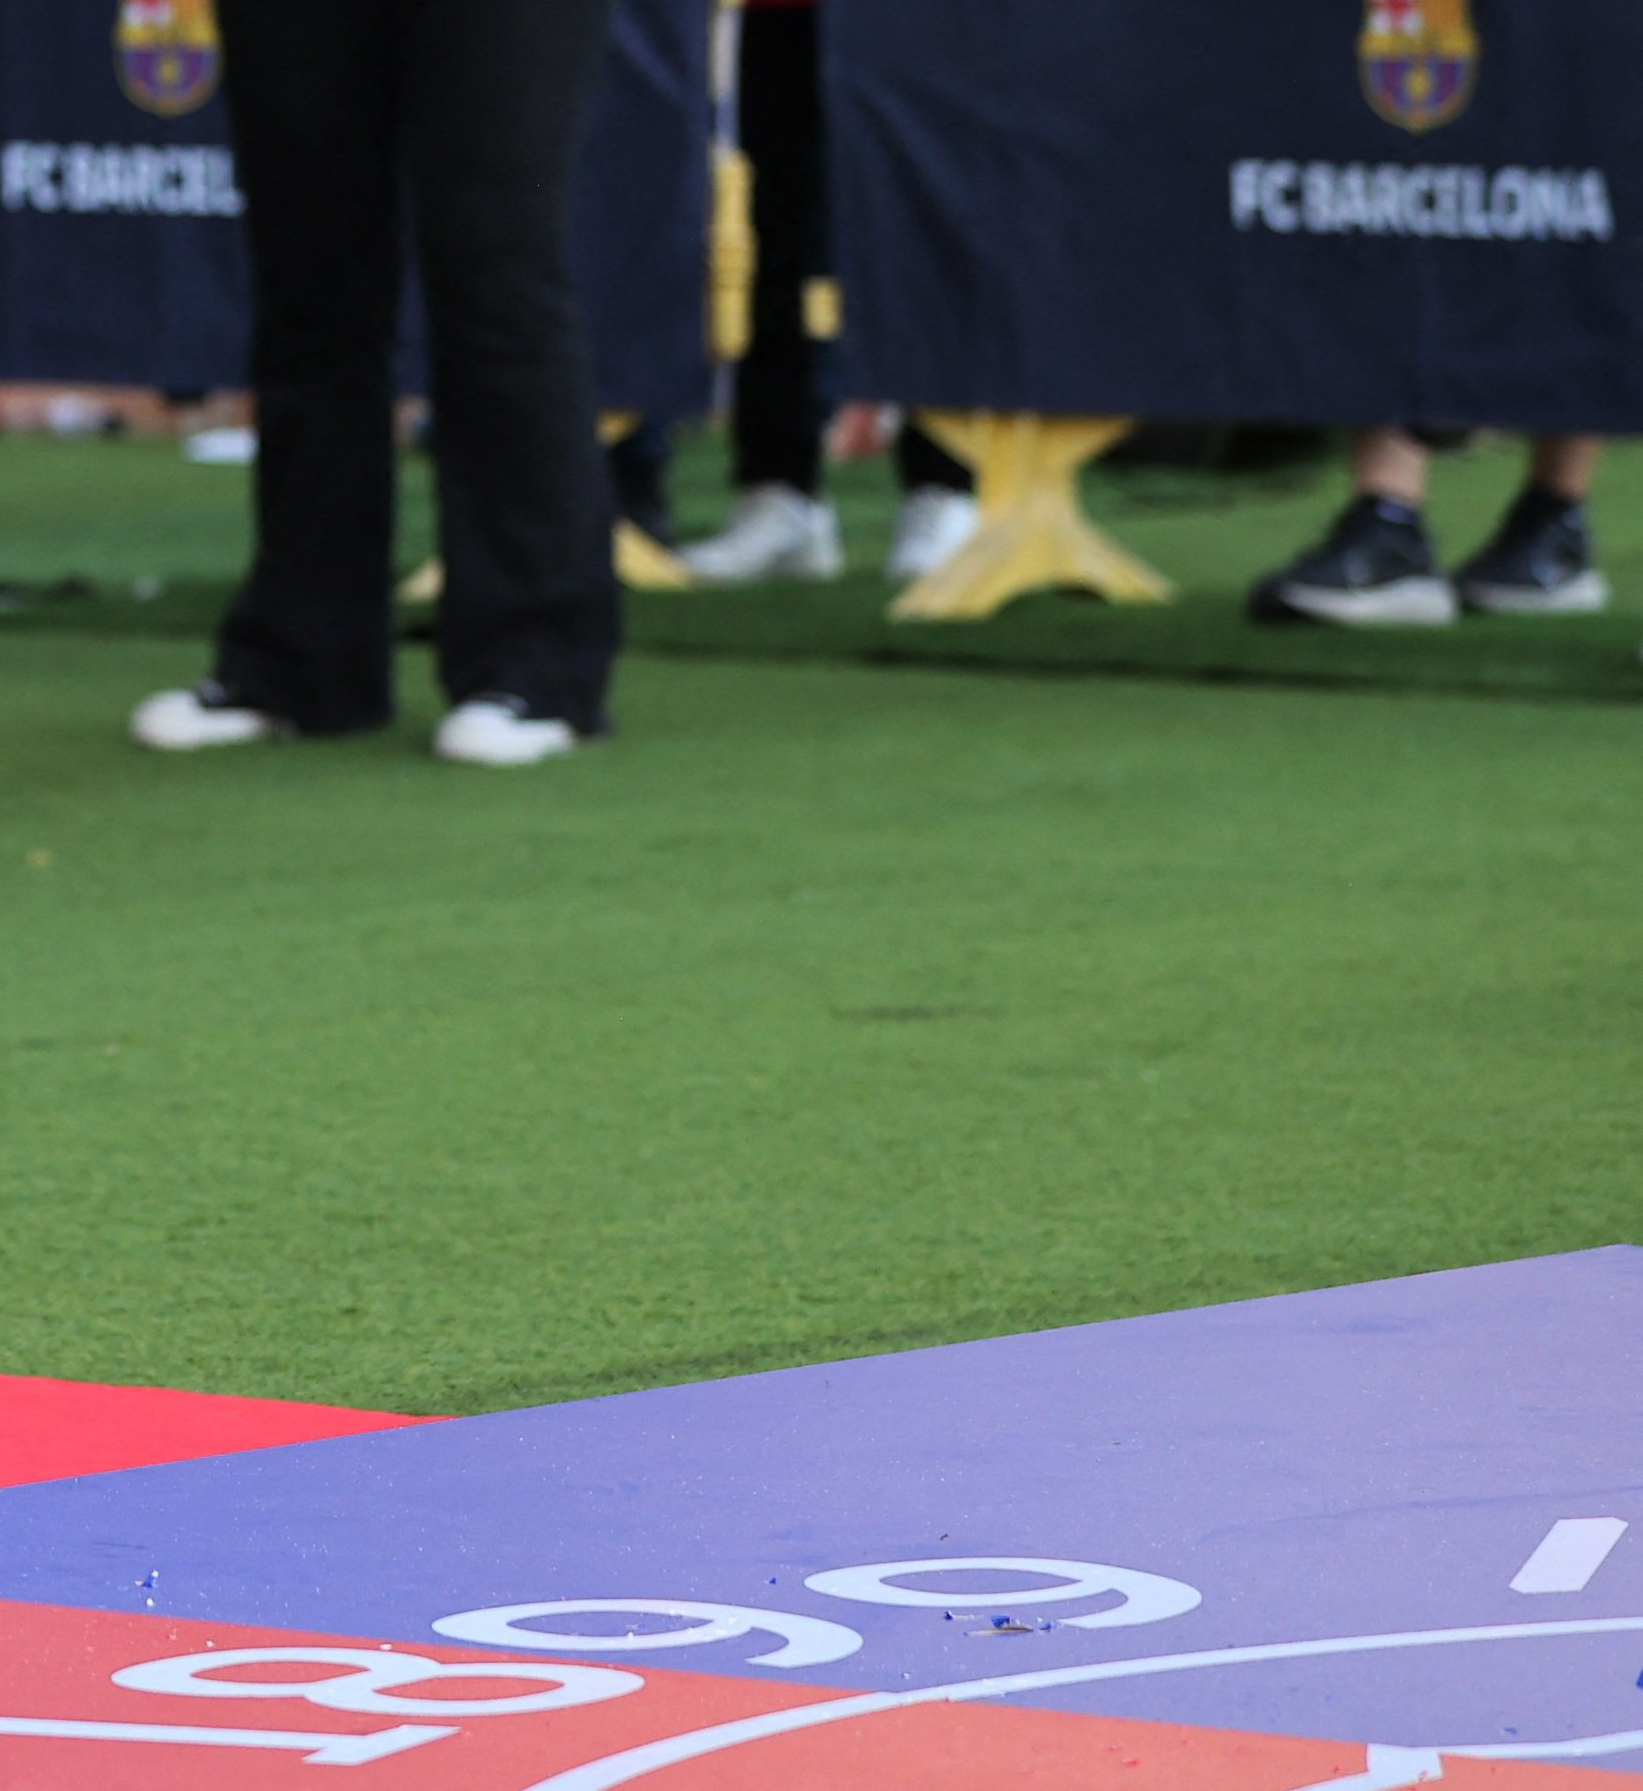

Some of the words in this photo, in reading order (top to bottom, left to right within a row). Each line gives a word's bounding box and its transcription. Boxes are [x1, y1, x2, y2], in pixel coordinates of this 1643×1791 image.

[65, 142, 246, 218] BARCEL
[1229, 157, 1300, 233] FC
[1302, 160, 1612, 242] BARCELONA
